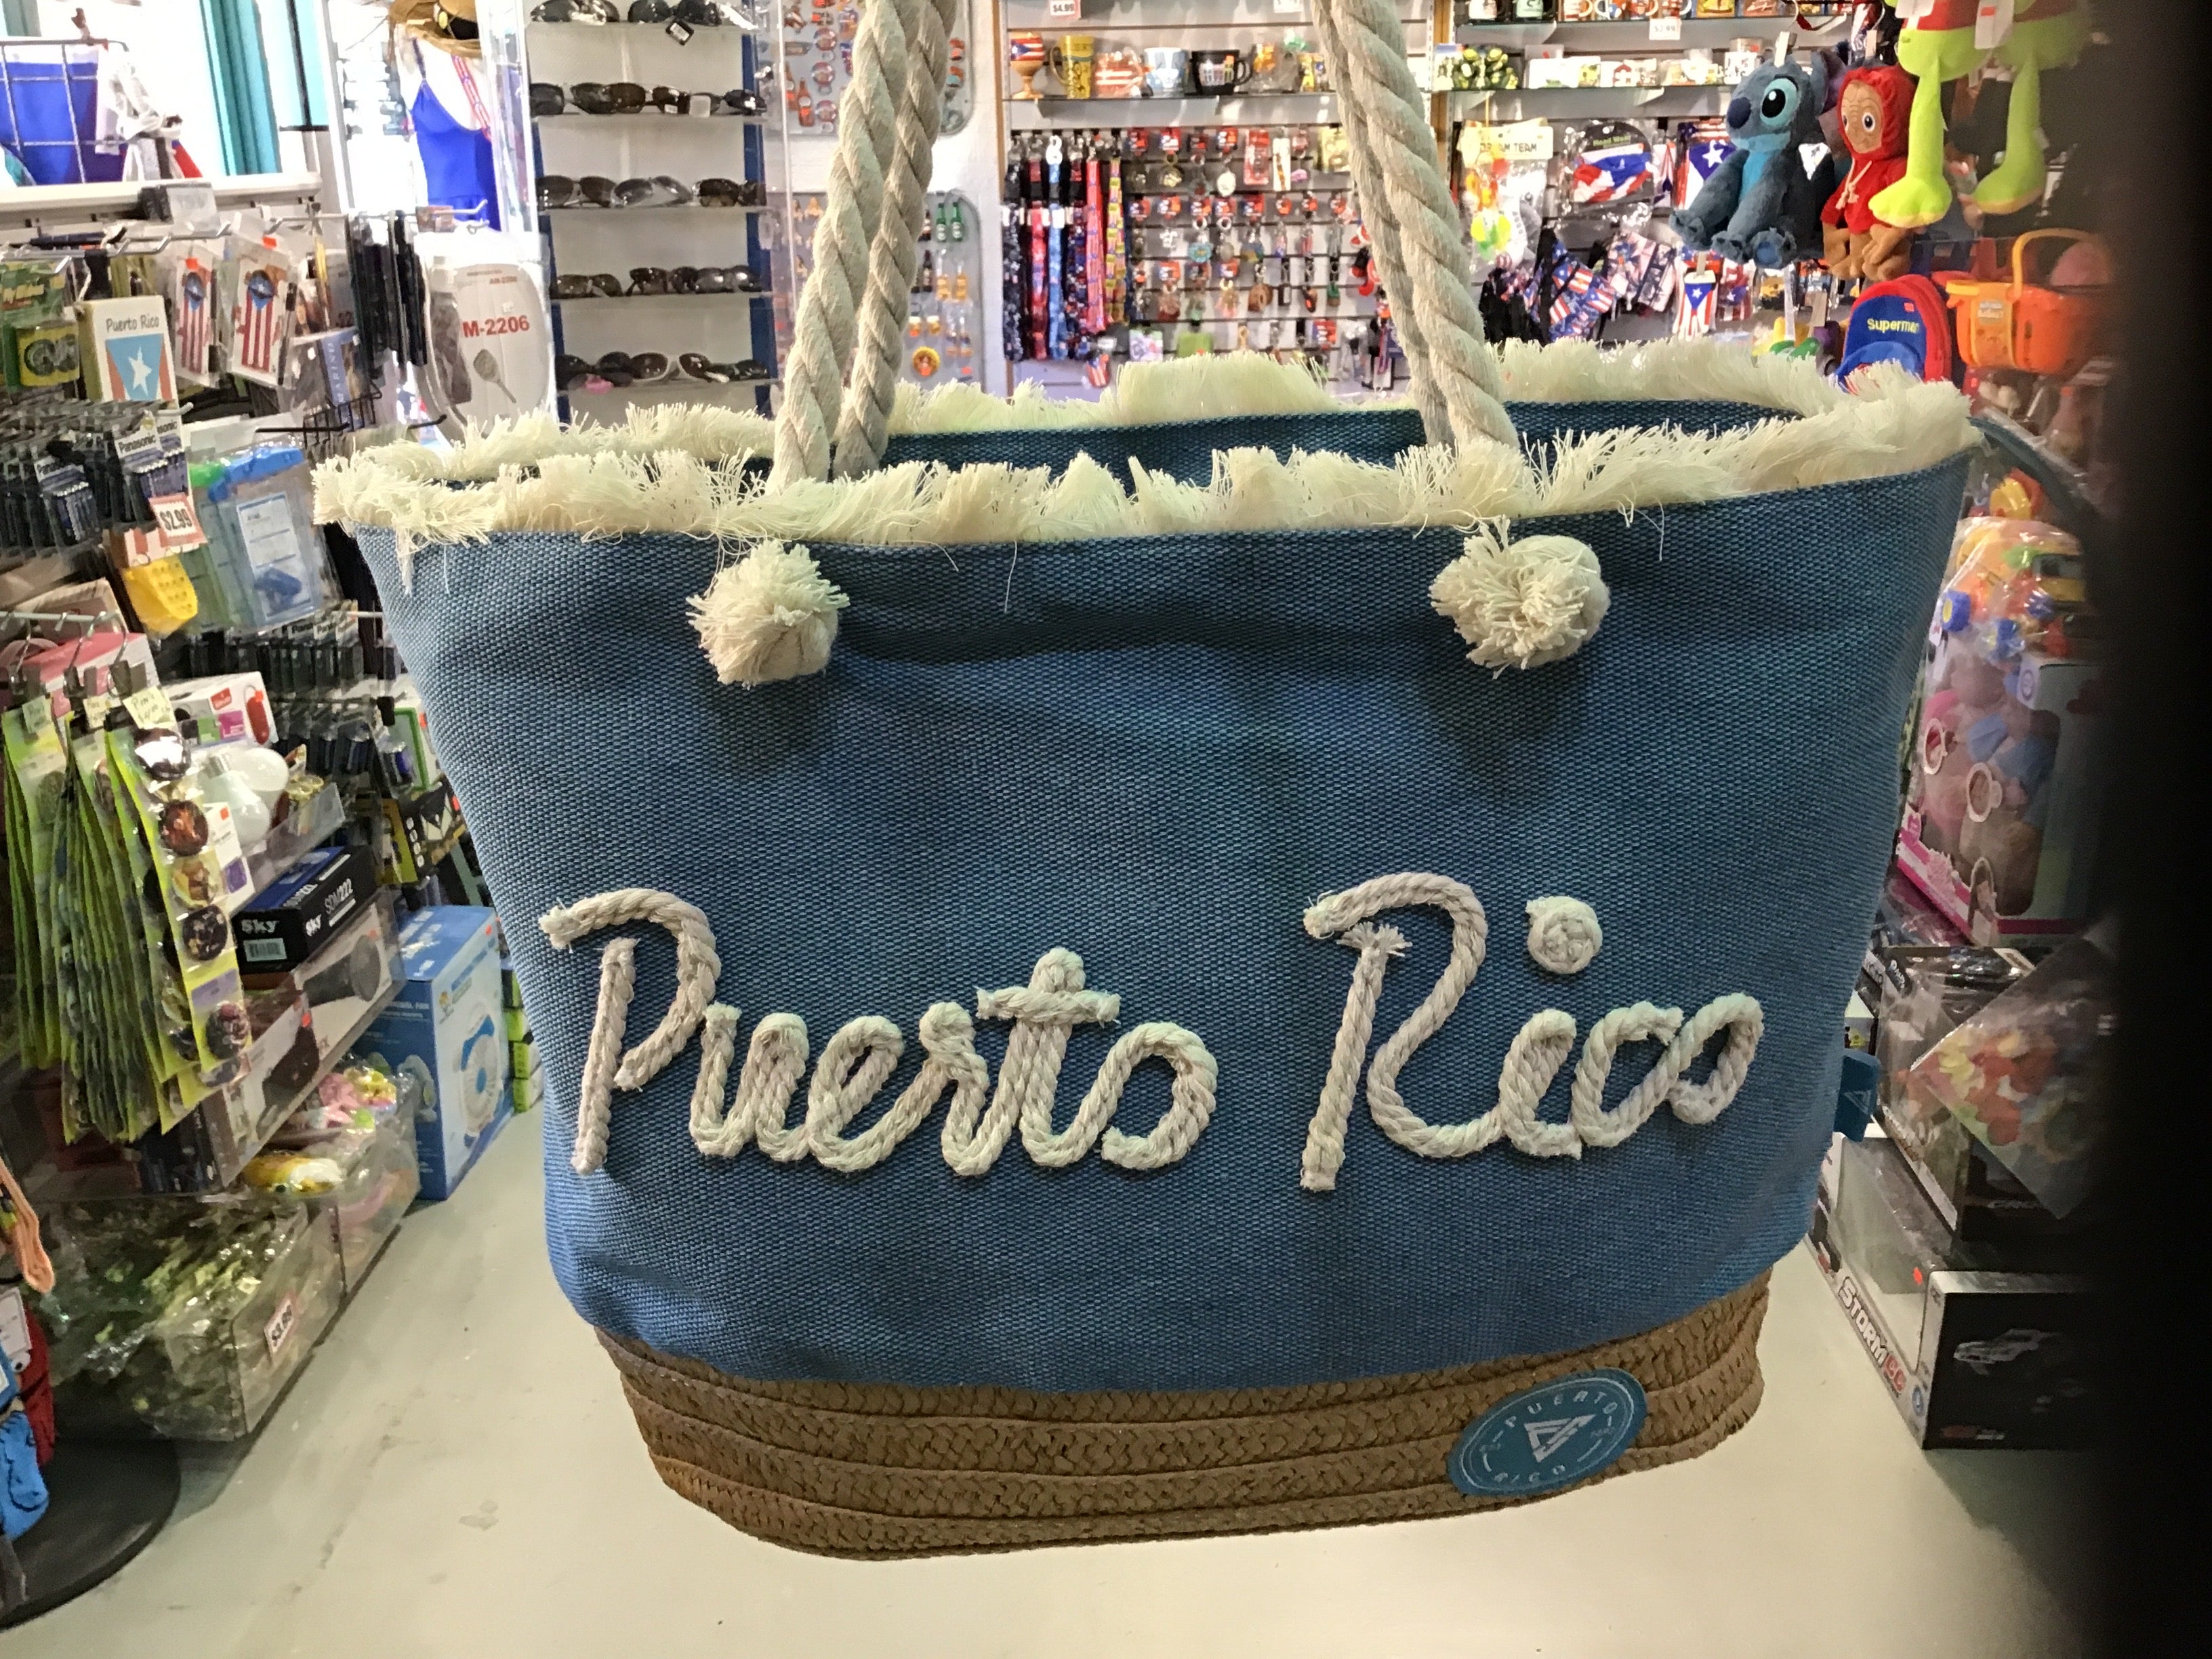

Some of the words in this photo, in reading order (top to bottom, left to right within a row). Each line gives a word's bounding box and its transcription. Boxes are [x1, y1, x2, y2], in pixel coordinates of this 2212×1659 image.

[1513, 142, 1538, 154] TEAM
[106, 316, 138, 333] Puerto
[140, 313, 160, 329] Rico
[462, 314, 531, 338] M-2206
[1867, 318, 1920, 334] Superman
[118, 432, 157, 455] Panasonic
[159, 508, 193, 532] $2.99
[539, 888, 1218, 1175] Puerto
[1300, 872, 1764, 1191] Rico
